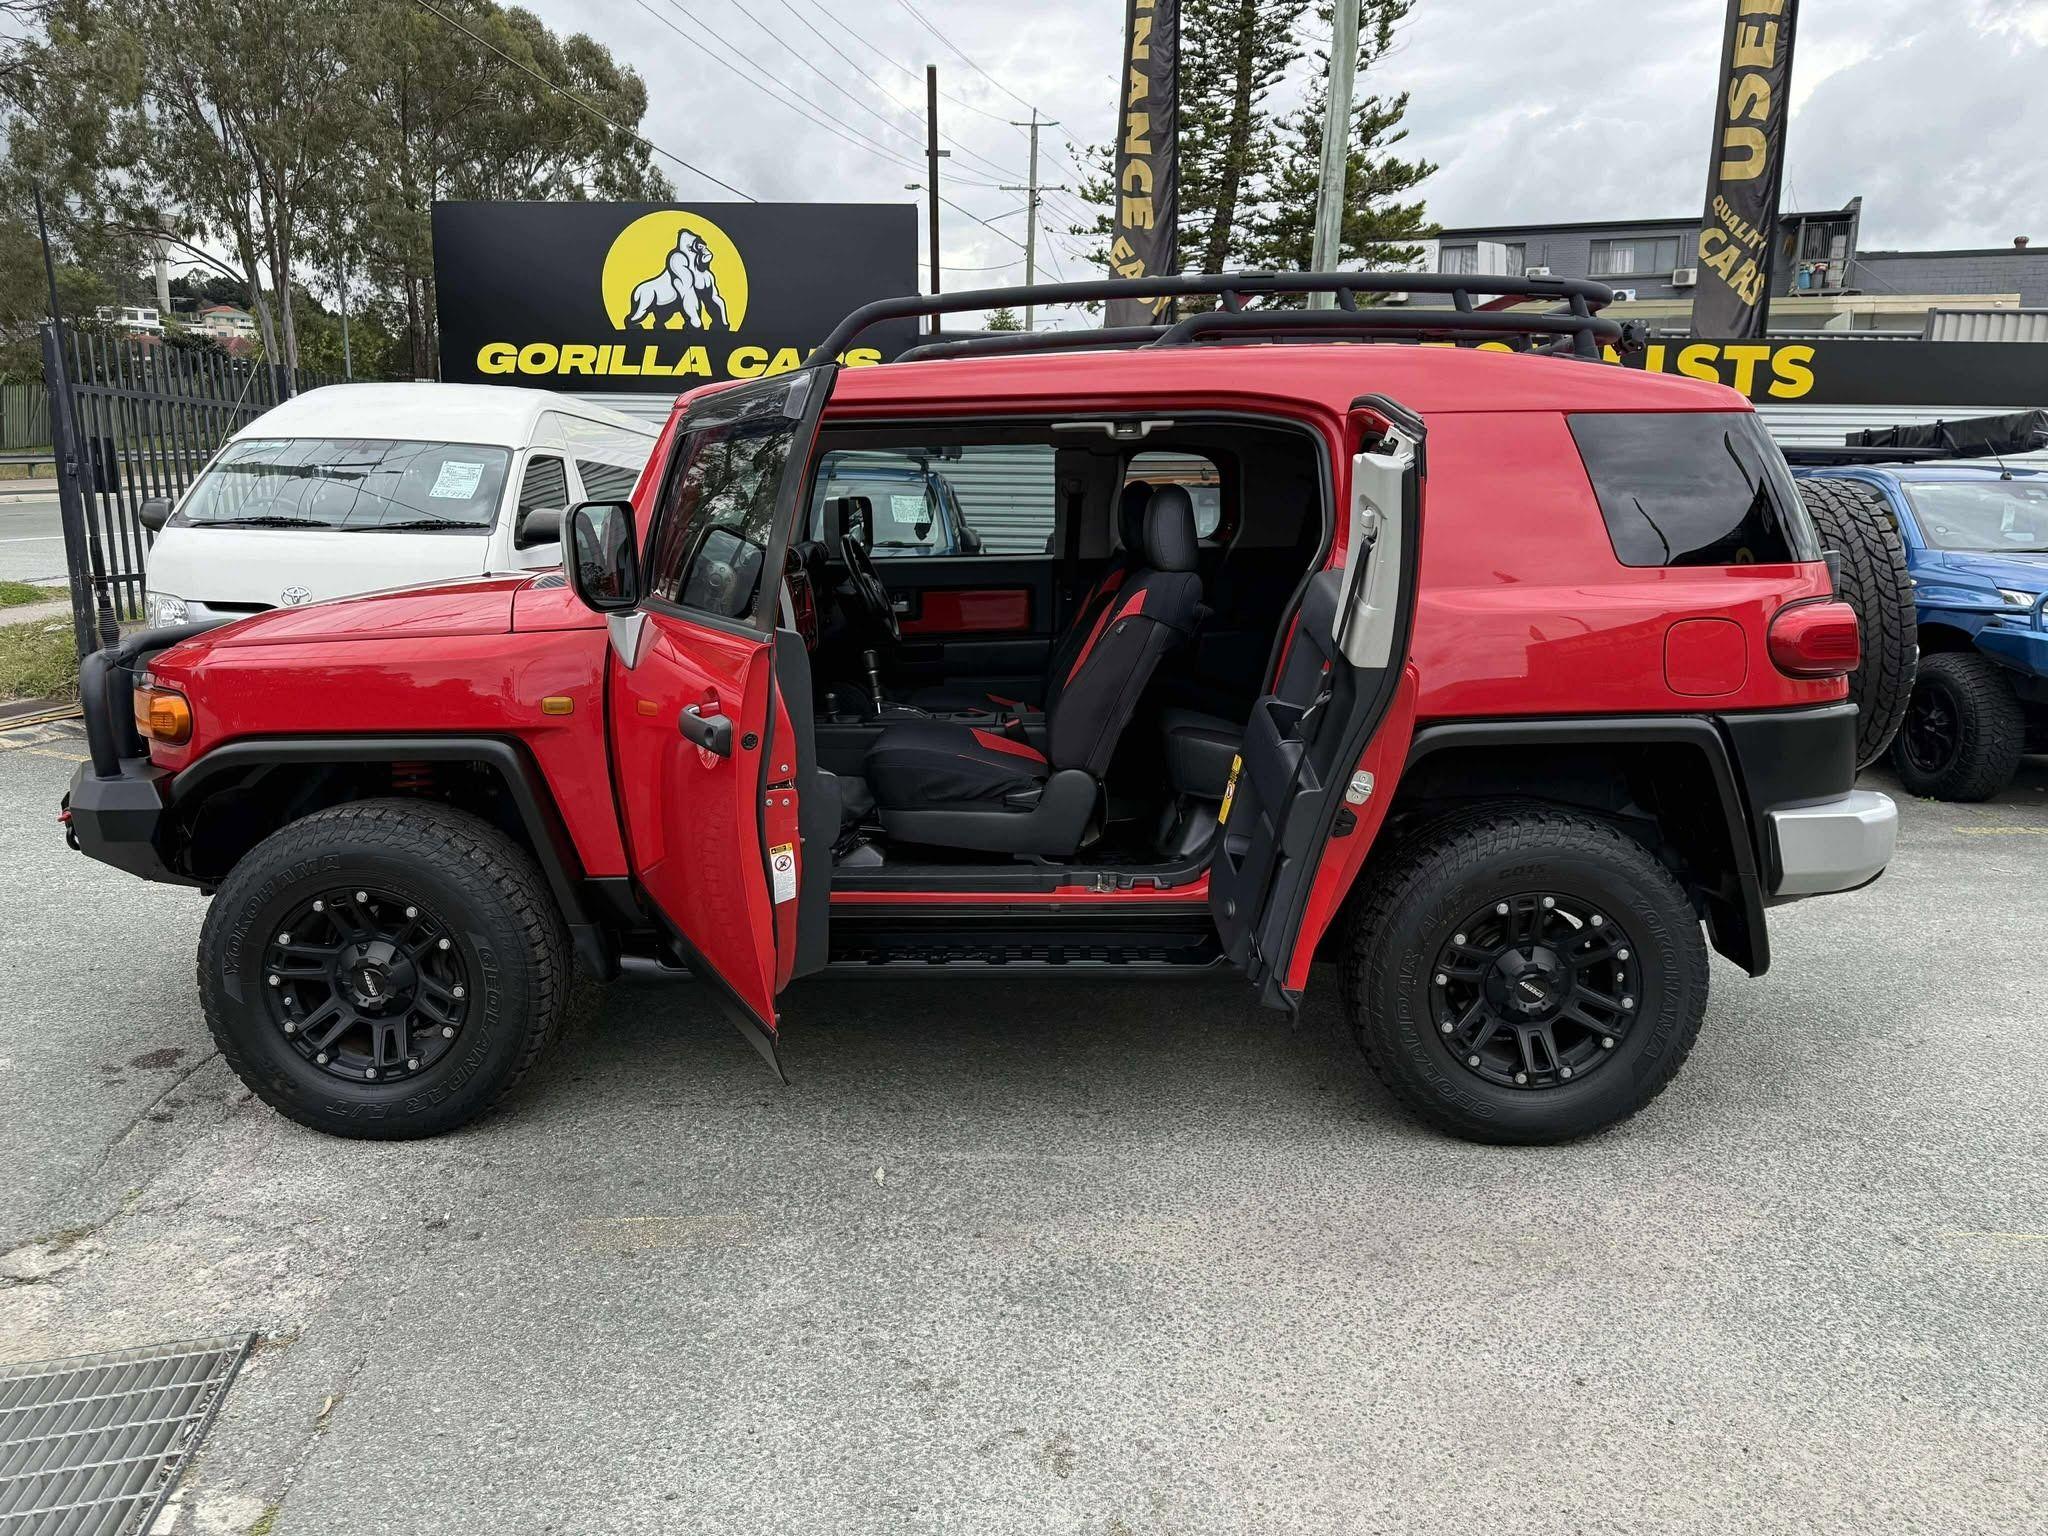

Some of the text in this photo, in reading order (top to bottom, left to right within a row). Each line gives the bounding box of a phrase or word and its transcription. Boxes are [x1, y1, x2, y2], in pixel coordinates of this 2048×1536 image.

[477, 342, 881, 379] GORILLA CAS
[224, 854, 341, 976] YOKOHAMA
